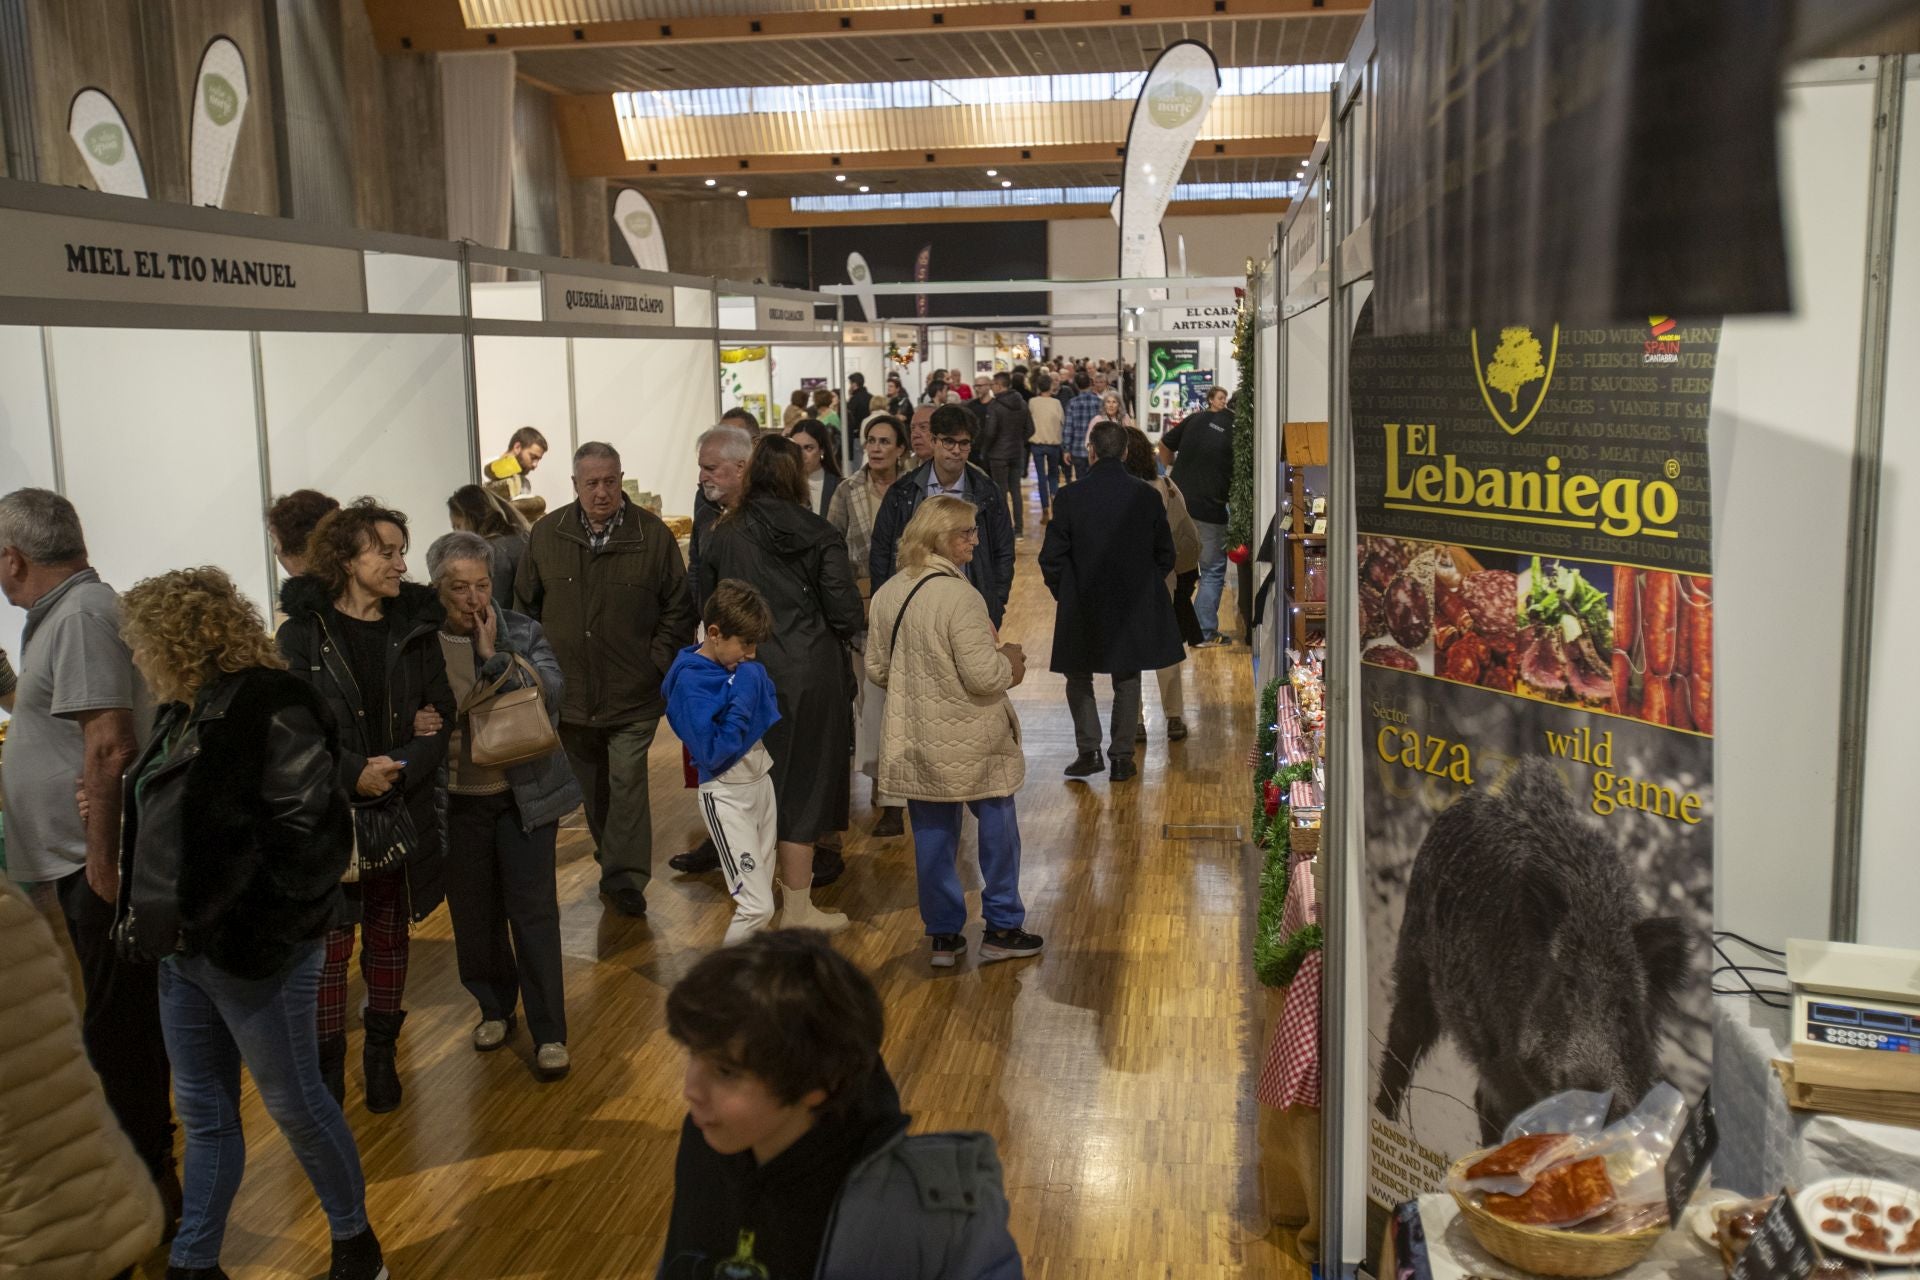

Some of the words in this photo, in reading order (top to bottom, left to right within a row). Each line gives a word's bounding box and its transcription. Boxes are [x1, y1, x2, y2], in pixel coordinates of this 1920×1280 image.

[64, 243, 131, 277] MIEL
[133, 250, 165, 280] EL
[167, 253, 207, 283] TIO
[210, 257, 297, 289] MANUEL
[565, 288, 610, 311] QUESERÍA
[610, 293, 638, 313] JAVIER
[1186, 307, 1202, 317] EL
[1571, 329, 1606, 344] UND
[1644, 340, 1681, 353] SPAIN
[1583, 353, 1638, 368] FLEISCH
[1643, 353, 1679, 363] CANTABRIA
[1569, 377, 1588, 391] ET
[1591, 377, 1659, 393] SAUCISSES
[1609, 400, 1661, 416] VIANDE
[1664, 402, 1682, 418] ET
[1405, 424, 1438, 456] El
[1571, 421, 1605, 437] AND
[1606, 422, 1673, 441] SAUSAGES
[1511, 441, 1589, 460] EMBUTIDOS
[1600, 446, 1640, 462] MEAT
[1383, 424, 1680, 538] Lebaniego
[1444, 520, 1490, 539] VIANDE
[1491, 526, 1508, 542] ET
[1508, 528, 1573, 549] SAUCISSES
[1581, 535, 1638, 556] FLEISCH
[1641, 543, 1672, 560] UND
[1377, 725, 1475, 785] caza
[1544, 726, 1615, 769] wild
[1591, 770, 1704, 825] game
[1371, 1117, 1408, 1149] CARNES
[1408, 1138, 1417, 1153] Y
[1371, 1133, 1397, 1158] MEAT
[1398, 1152, 1421, 1172] AND
[1371, 1149, 1408, 1181] VIANDE
[1409, 1172, 1422, 1189] ET
[1371, 1165, 1409, 1198] FLEISCH
